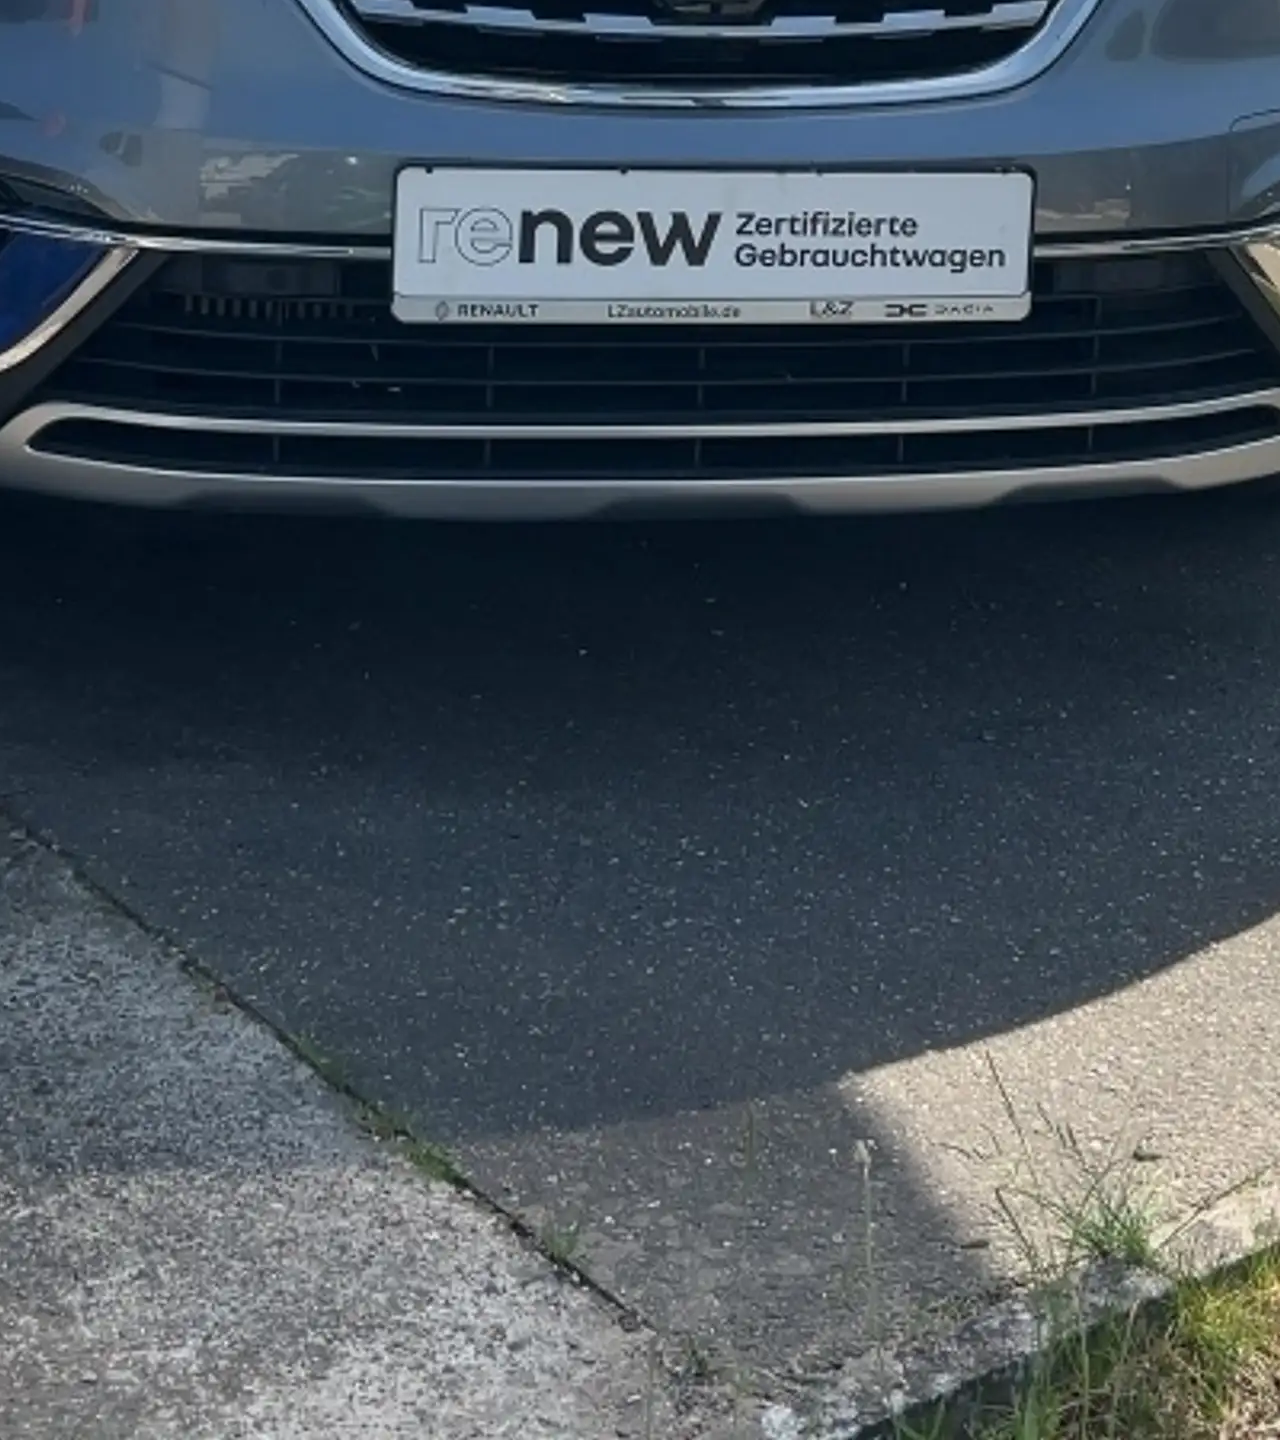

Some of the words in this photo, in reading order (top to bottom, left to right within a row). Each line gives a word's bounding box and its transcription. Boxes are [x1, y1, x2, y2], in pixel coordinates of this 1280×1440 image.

[419, 208, 722, 266] renew
[735, 212, 919, 237] Zertifizierte
[734, 243, 1007, 273] Gebrauchtwagen
[457, 304, 539, 318] RENAULT
